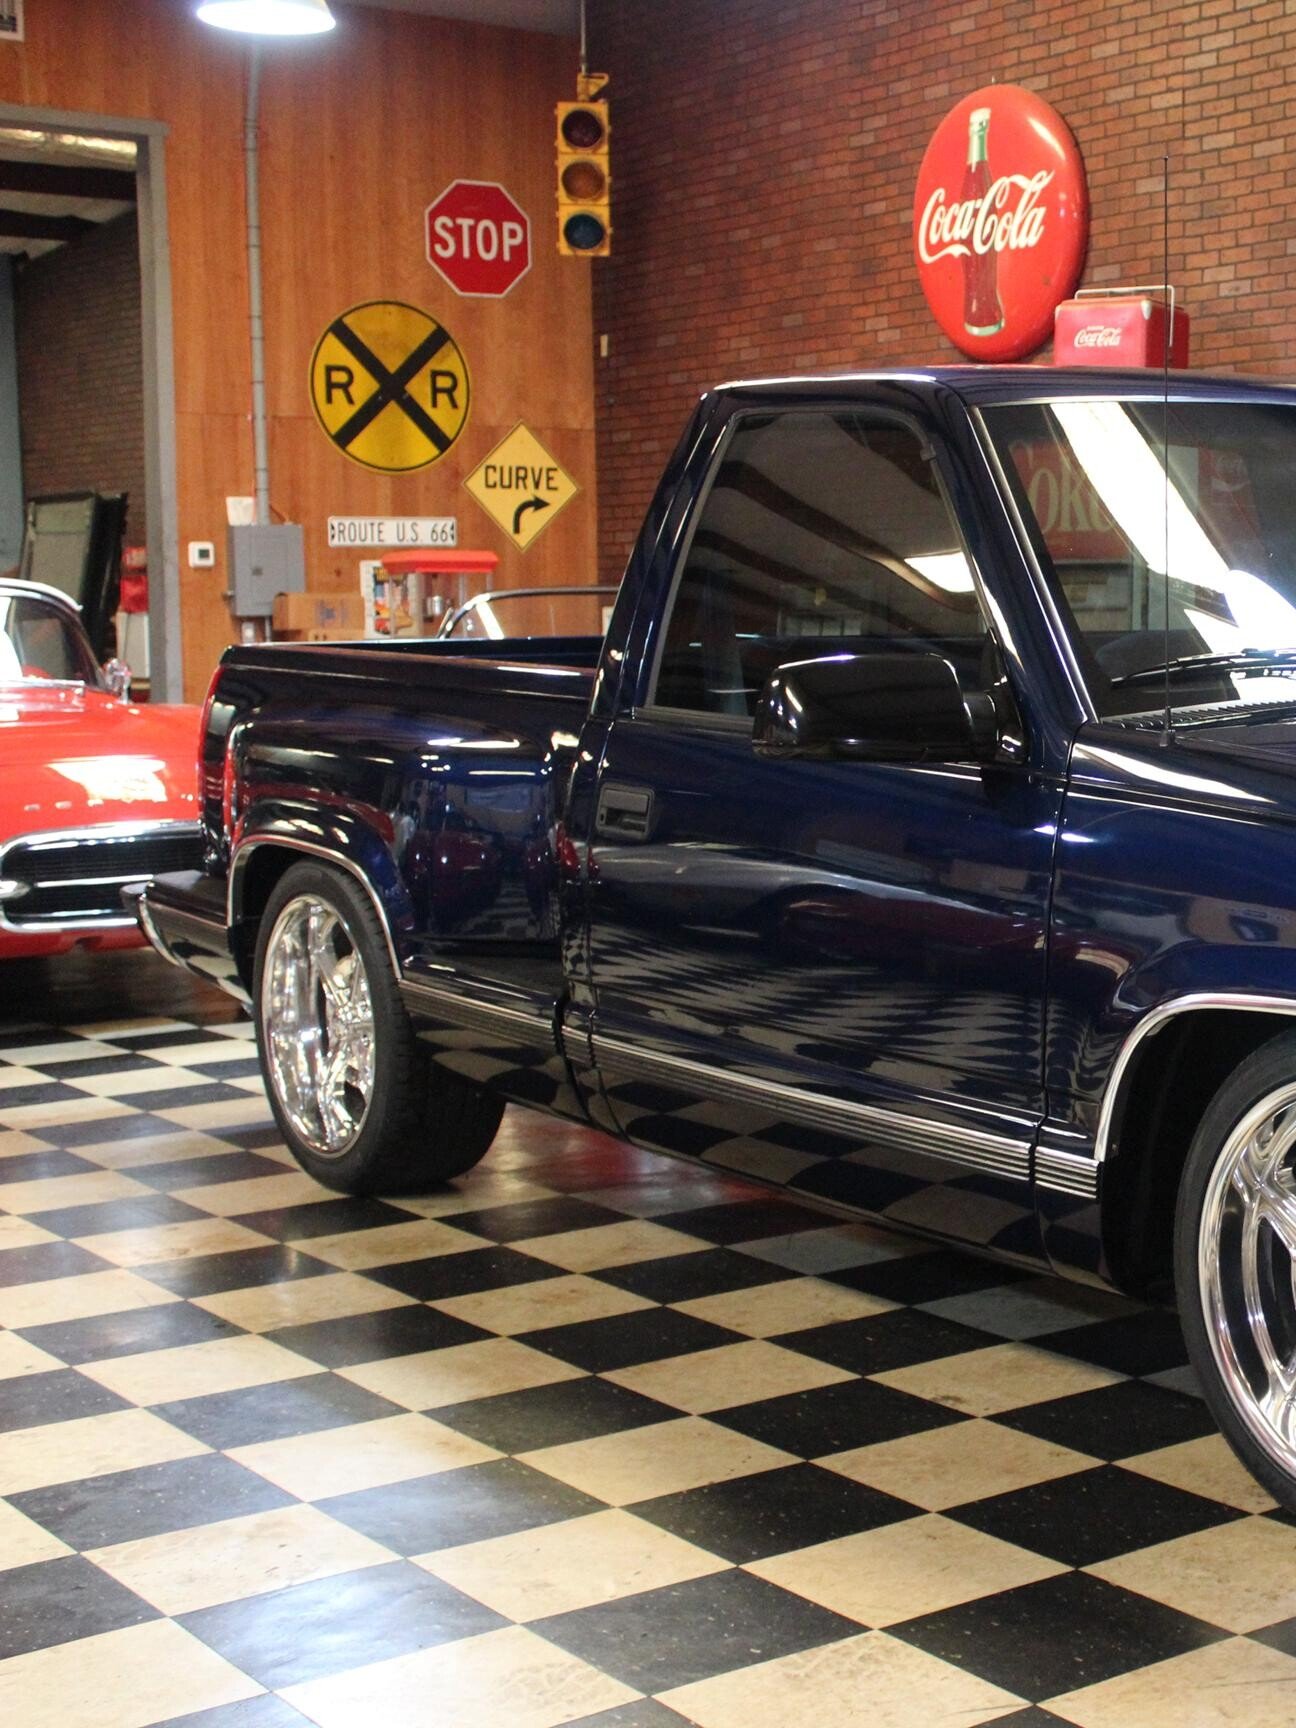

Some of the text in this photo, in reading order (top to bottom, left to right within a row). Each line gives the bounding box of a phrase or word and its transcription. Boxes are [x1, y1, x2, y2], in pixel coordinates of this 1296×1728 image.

[434, 216, 524, 262] STOP
[918, 170, 1055, 264] Coca-Cola
[324, 364, 459, 409] R R
[484, 464, 559, 491] CURVE
[336, 521, 449, 544] ROUTE U.S. 66
